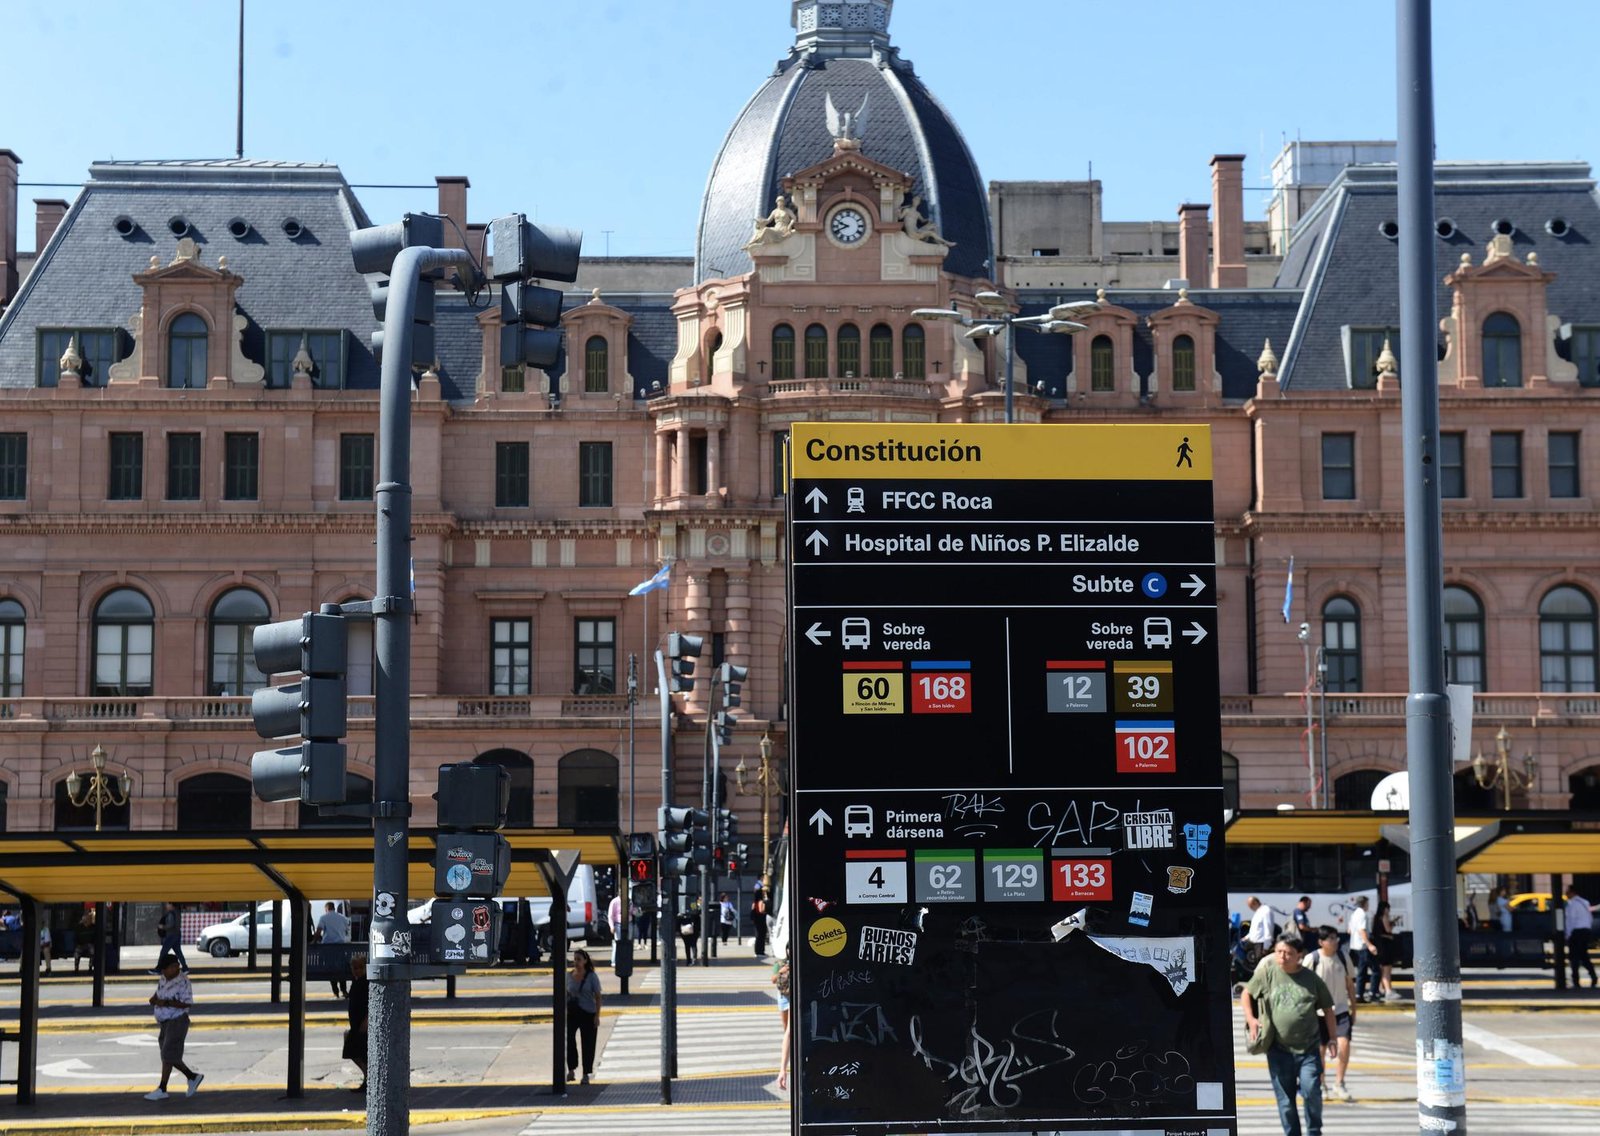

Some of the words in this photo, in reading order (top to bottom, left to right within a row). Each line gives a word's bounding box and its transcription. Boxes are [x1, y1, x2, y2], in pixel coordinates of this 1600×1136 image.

[806, 438, 981, 462] Constitución
[882, 493, 935, 510] FFCC
[942, 493, 992, 510] Roca
[845, 534, 931, 555] Hospital
[938, 534, 963, 552] de
[971, 534, 1030, 552] Niños
[1038, 535, 1053, 552] P.
[1061, 534, 1139, 552] Elizalde
[1073, 576, 1134, 593] Subte
[1148, 578, 1159, 592] C
[883, 623, 925, 636] Sobre
[1092, 623, 1133, 636] Sobre
[883, 638, 930, 651] vereda
[1086, 637, 1133, 650] vereda
[858, 678, 889, 700] 60
[920, 677, 965, 699] 168
[1063, 676, 1092, 698] 12
[1128, 676, 1160, 699] 39
[1124, 736, 1169, 759] 102
[886, 810, 941, 823] Primera
[1125, 814, 1171, 824] CRISTINA
[886, 825, 943, 839] dársena
[1127, 826, 1173, 848] LIBRE
[868, 867, 885, 888] 4
[929, 865, 962, 888] 62
[992, 864, 1037, 887] 129
[1060, 864, 1105, 887] 133
[813, 928, 842, 943] Sokets
[865, 928, 914, 947] BUENOS
